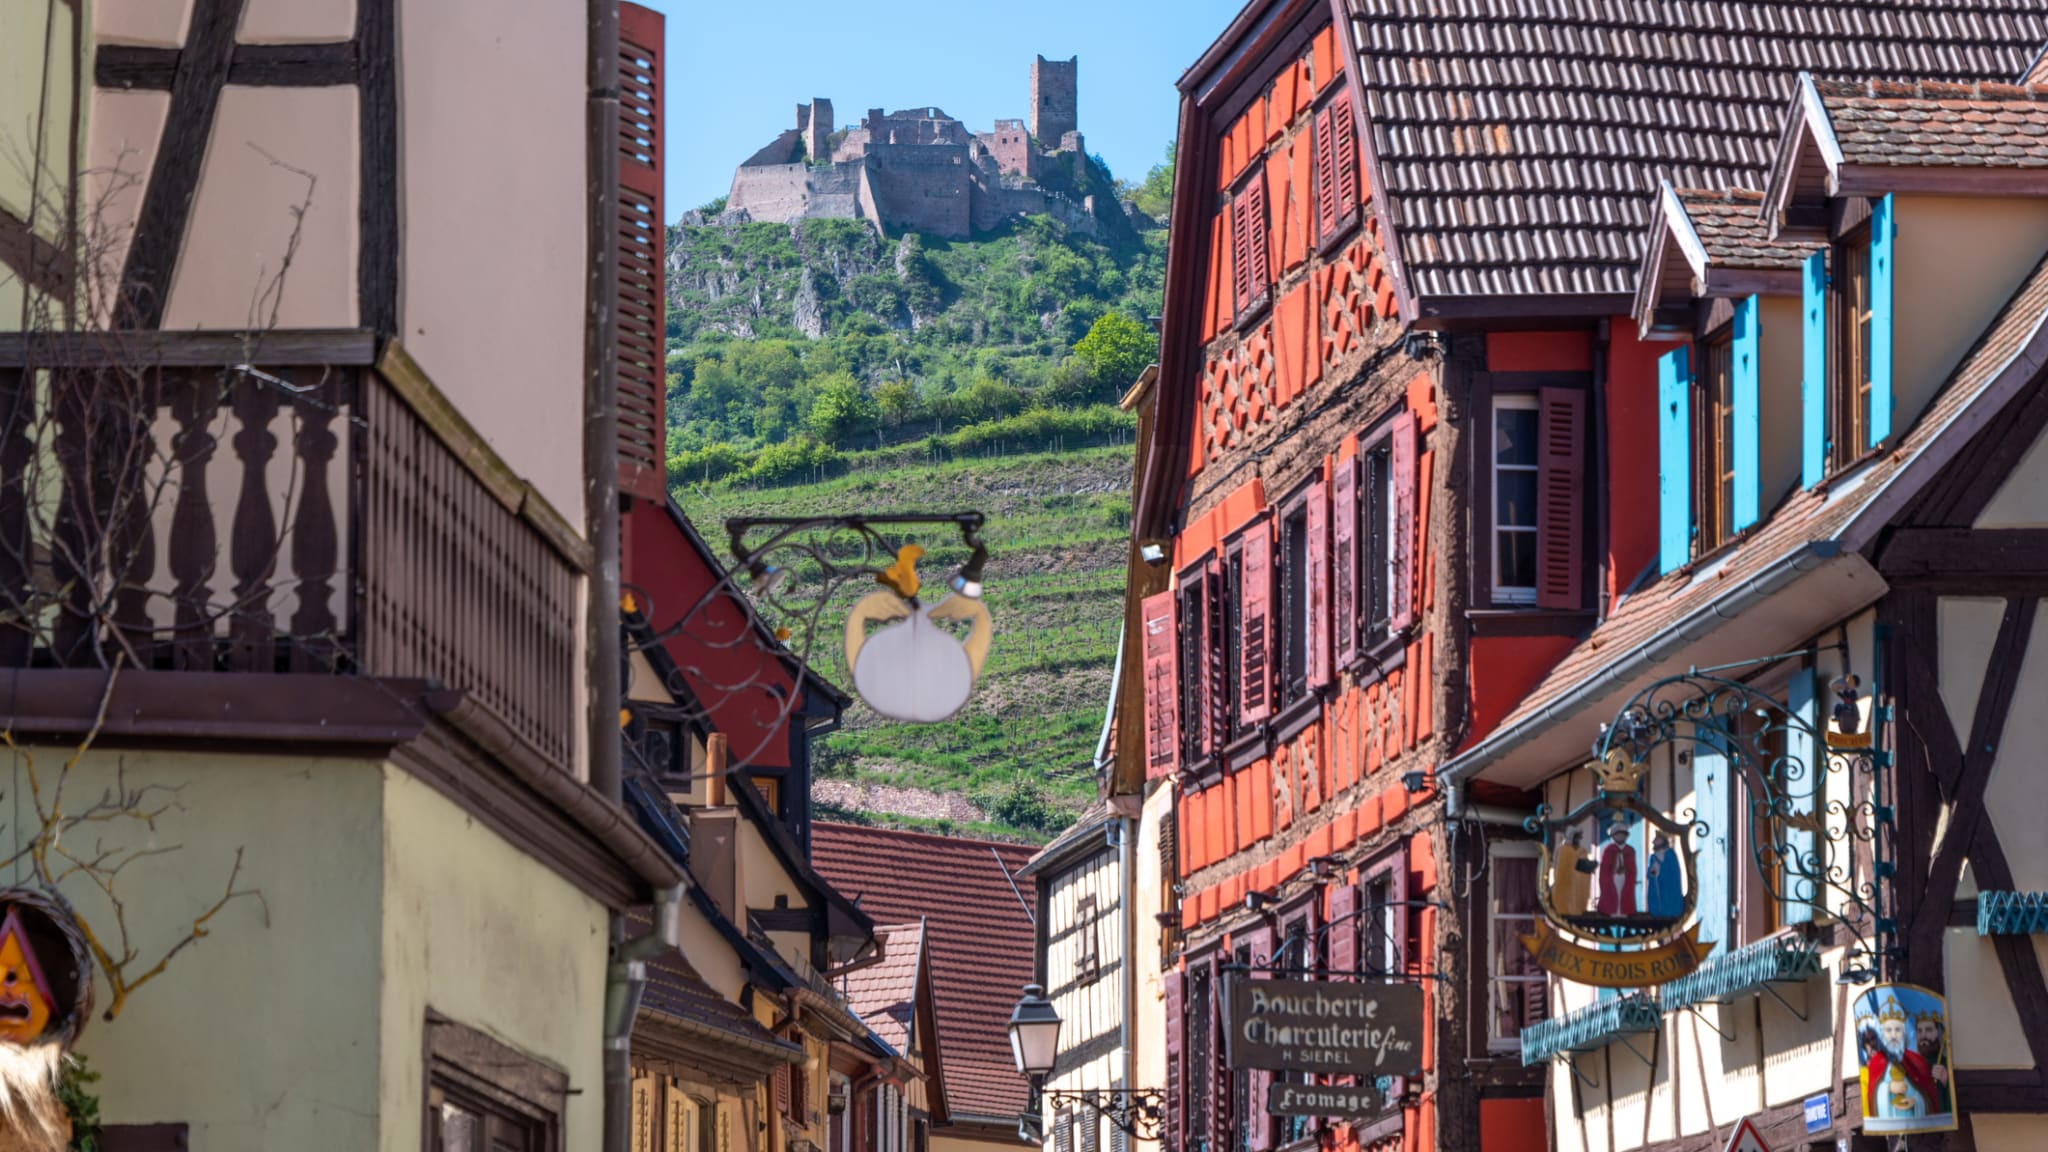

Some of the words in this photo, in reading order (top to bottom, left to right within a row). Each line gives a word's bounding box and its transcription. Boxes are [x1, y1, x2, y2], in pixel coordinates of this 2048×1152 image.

[1543, 944, 1583, 975] AUX
[1589, 958, 1648, 980] TROIS
[1250, 987, 1379, 1019] Boucherie
[1243, 1017, 1382, 1049] Charcuterie
[1279, 1087, 1372, 1113] Fromage
